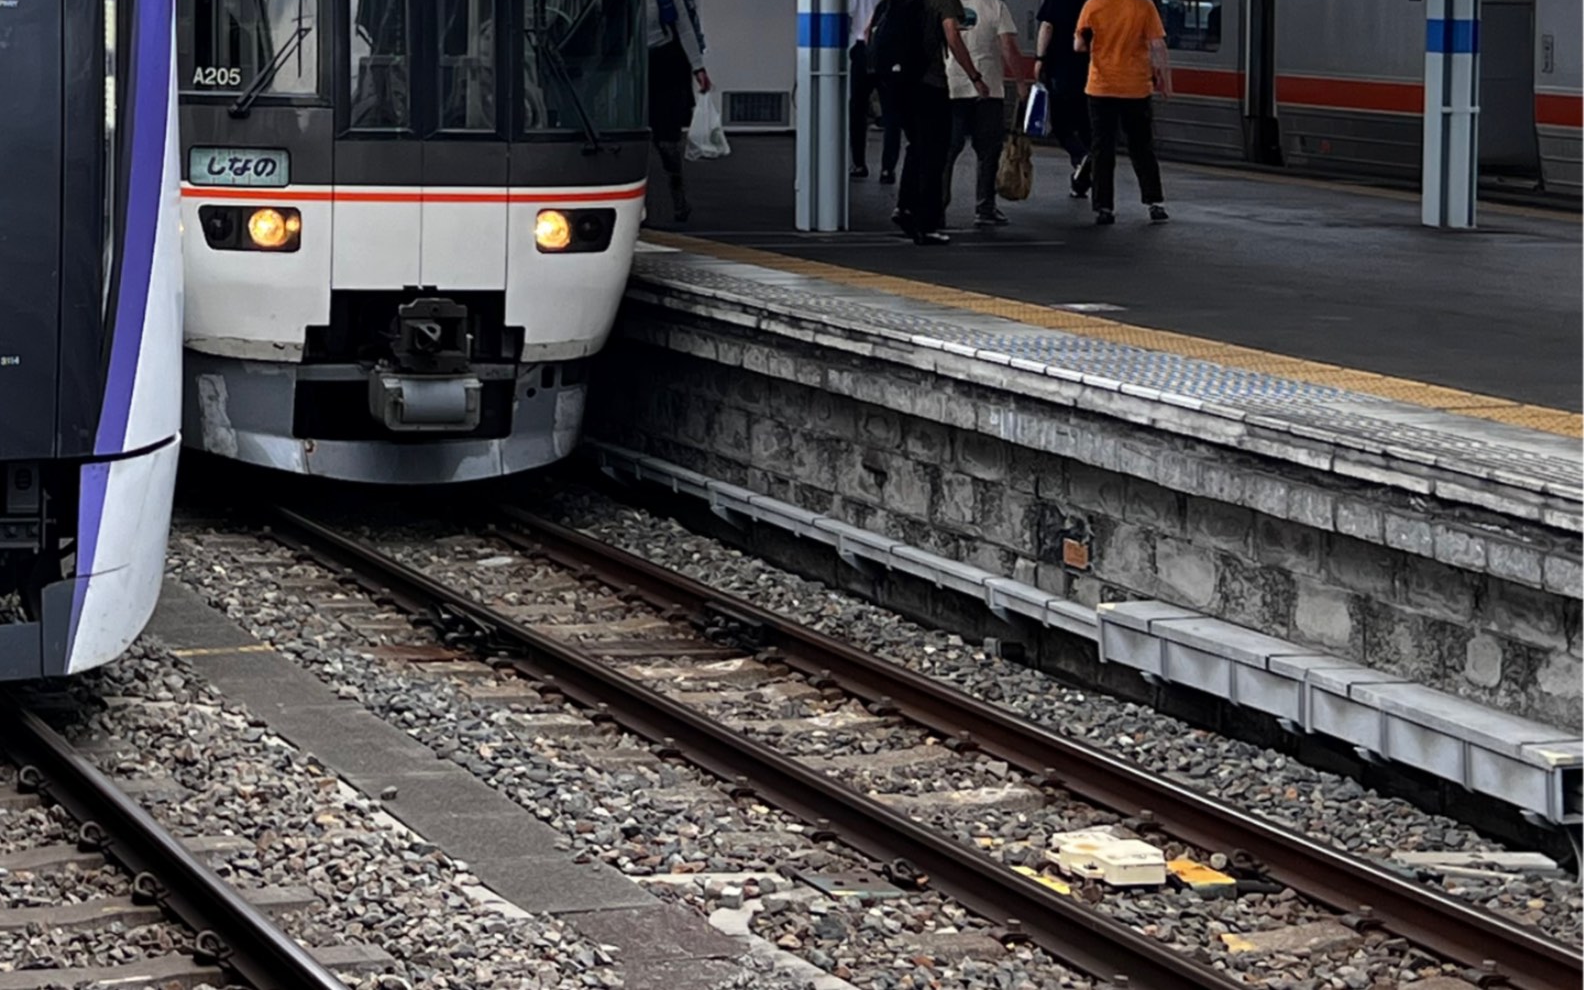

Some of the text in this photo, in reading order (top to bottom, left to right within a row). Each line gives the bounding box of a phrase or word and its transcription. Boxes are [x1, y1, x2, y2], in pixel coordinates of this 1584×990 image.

[192, 67, 241, 85] A205
[207, 156, 277, 177] しなの
